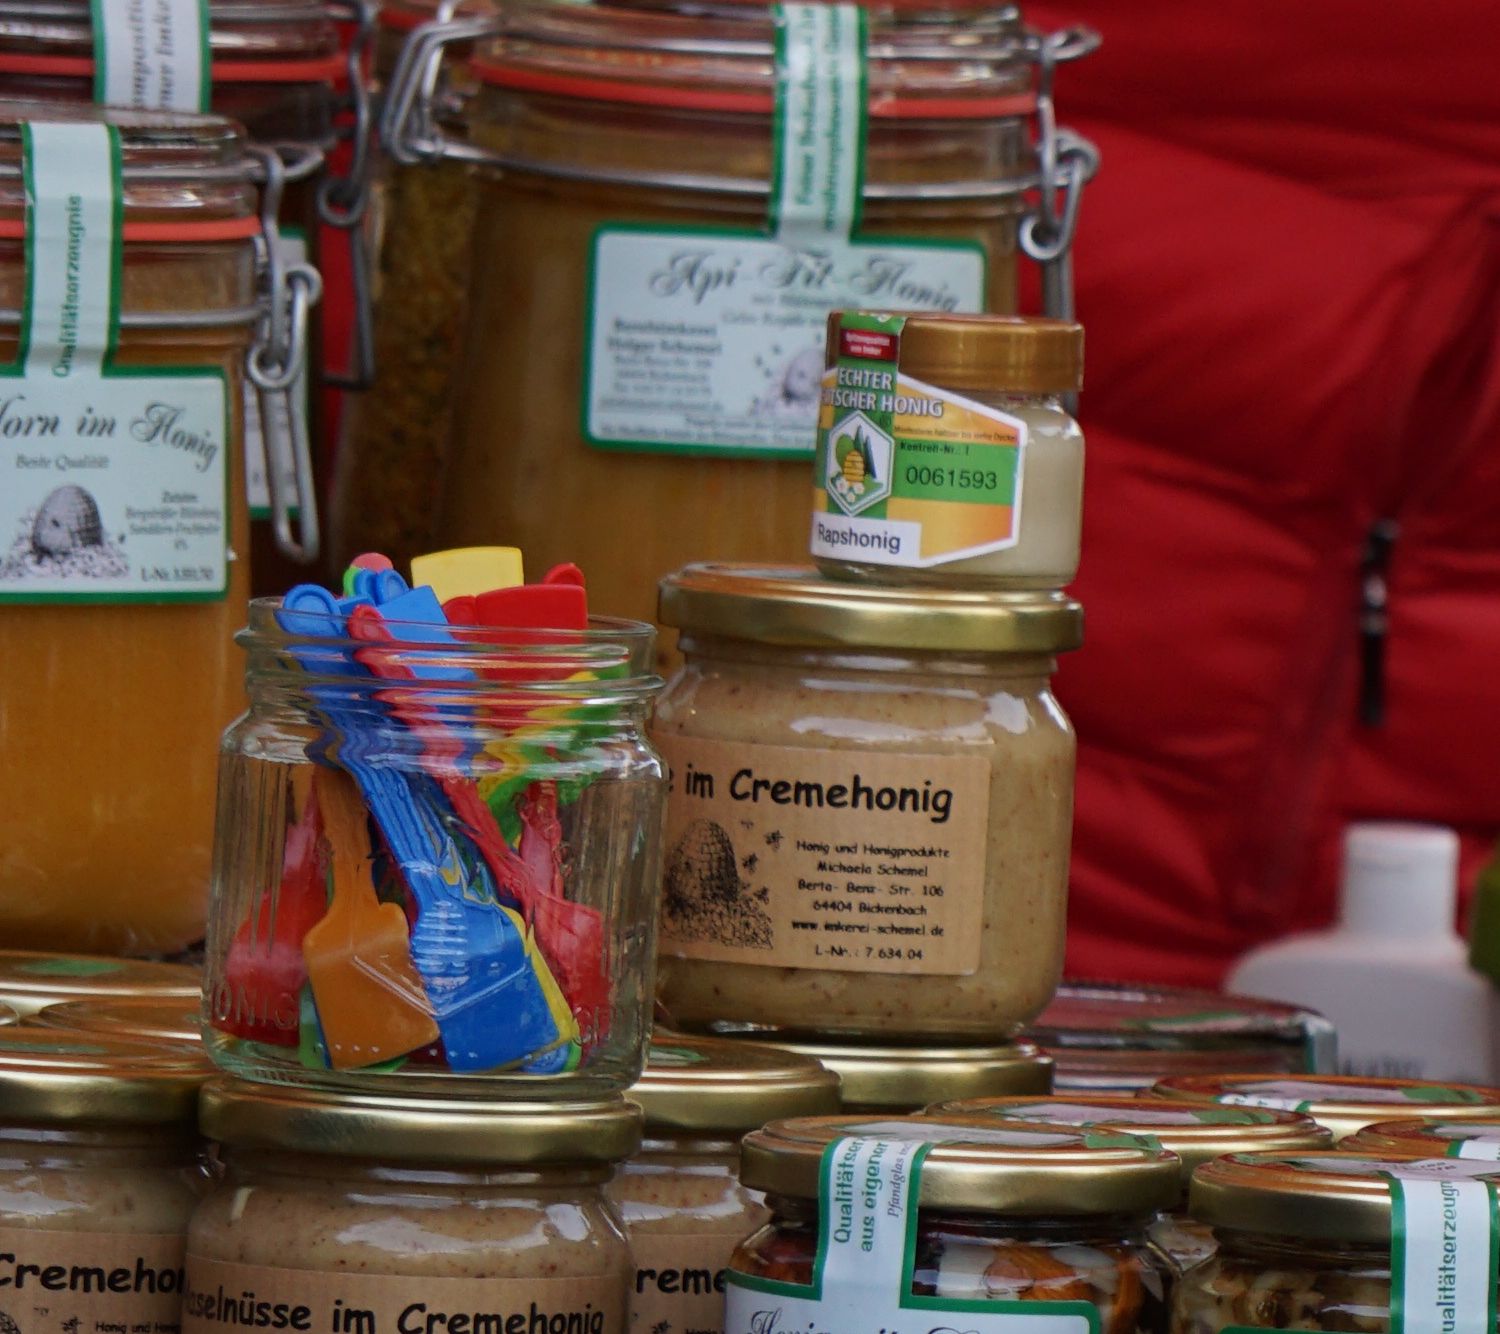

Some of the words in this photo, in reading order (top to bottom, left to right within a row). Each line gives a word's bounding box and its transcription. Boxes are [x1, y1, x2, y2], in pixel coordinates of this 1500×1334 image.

[52, 194, 86, 377] Qualitätserzeugnis
[837, 369, 893, 391] ECHTER
[881, 396, 944, 418] HONIG
[77, 406, 116, 437] im
[129, 402, 219, 472] Honig
[906, 466, 998, 490] 0061593
[818, 523, 901, 554] Rapshonig
[686, 764, 714, 799] im
[730, 768, 953, 823] Cremehonig
[796, 840, 830, 854] Honig
[835, 842, 858, 854] und
[863, 844, 950, 858] Honigprodukte
[817, 860, 872, 874] Michaela
[877, 864, 928, 877] Schemel
[922, 884, 944, 897] 106
[813, 900, 853, 912] 64404
[858, 902, 927, 916] Bickenbach
[861, 1142, 889, 1209] eigener
[887, 1157, 906, 1219] Pfandglas
[834, 1140, 864, 1244] Qualitätser
[861, 1216, 875, 1253] aus
